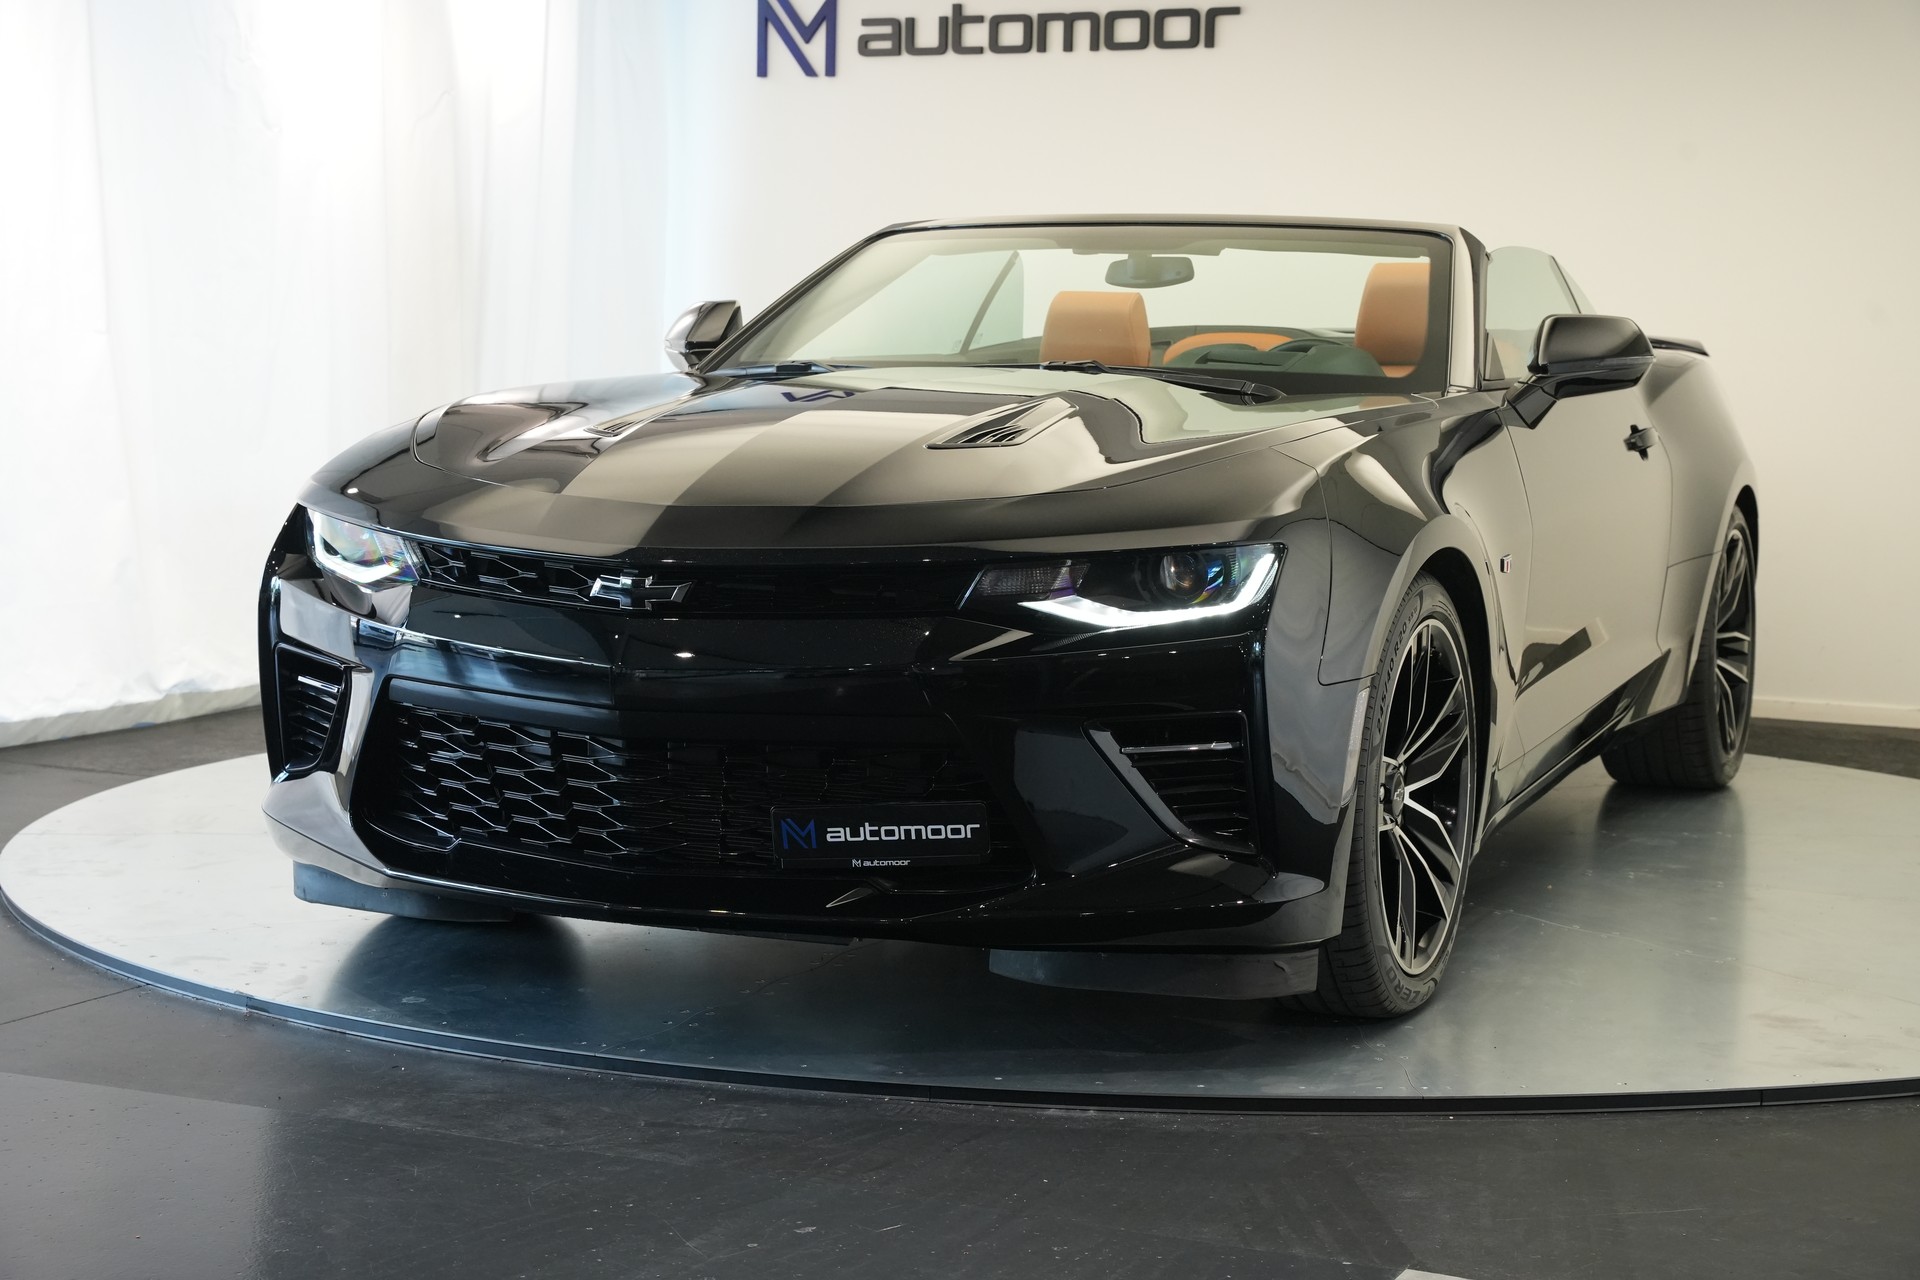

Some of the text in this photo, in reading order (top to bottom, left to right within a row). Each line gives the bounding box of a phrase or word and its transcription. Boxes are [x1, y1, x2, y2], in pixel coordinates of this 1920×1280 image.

[858, 3, 1241, 57] automoor
[826, 822, 980, 842] automoor
[863, 859, 911, 867] automoor
[1386, 966, 1421, 1004] ZERO
